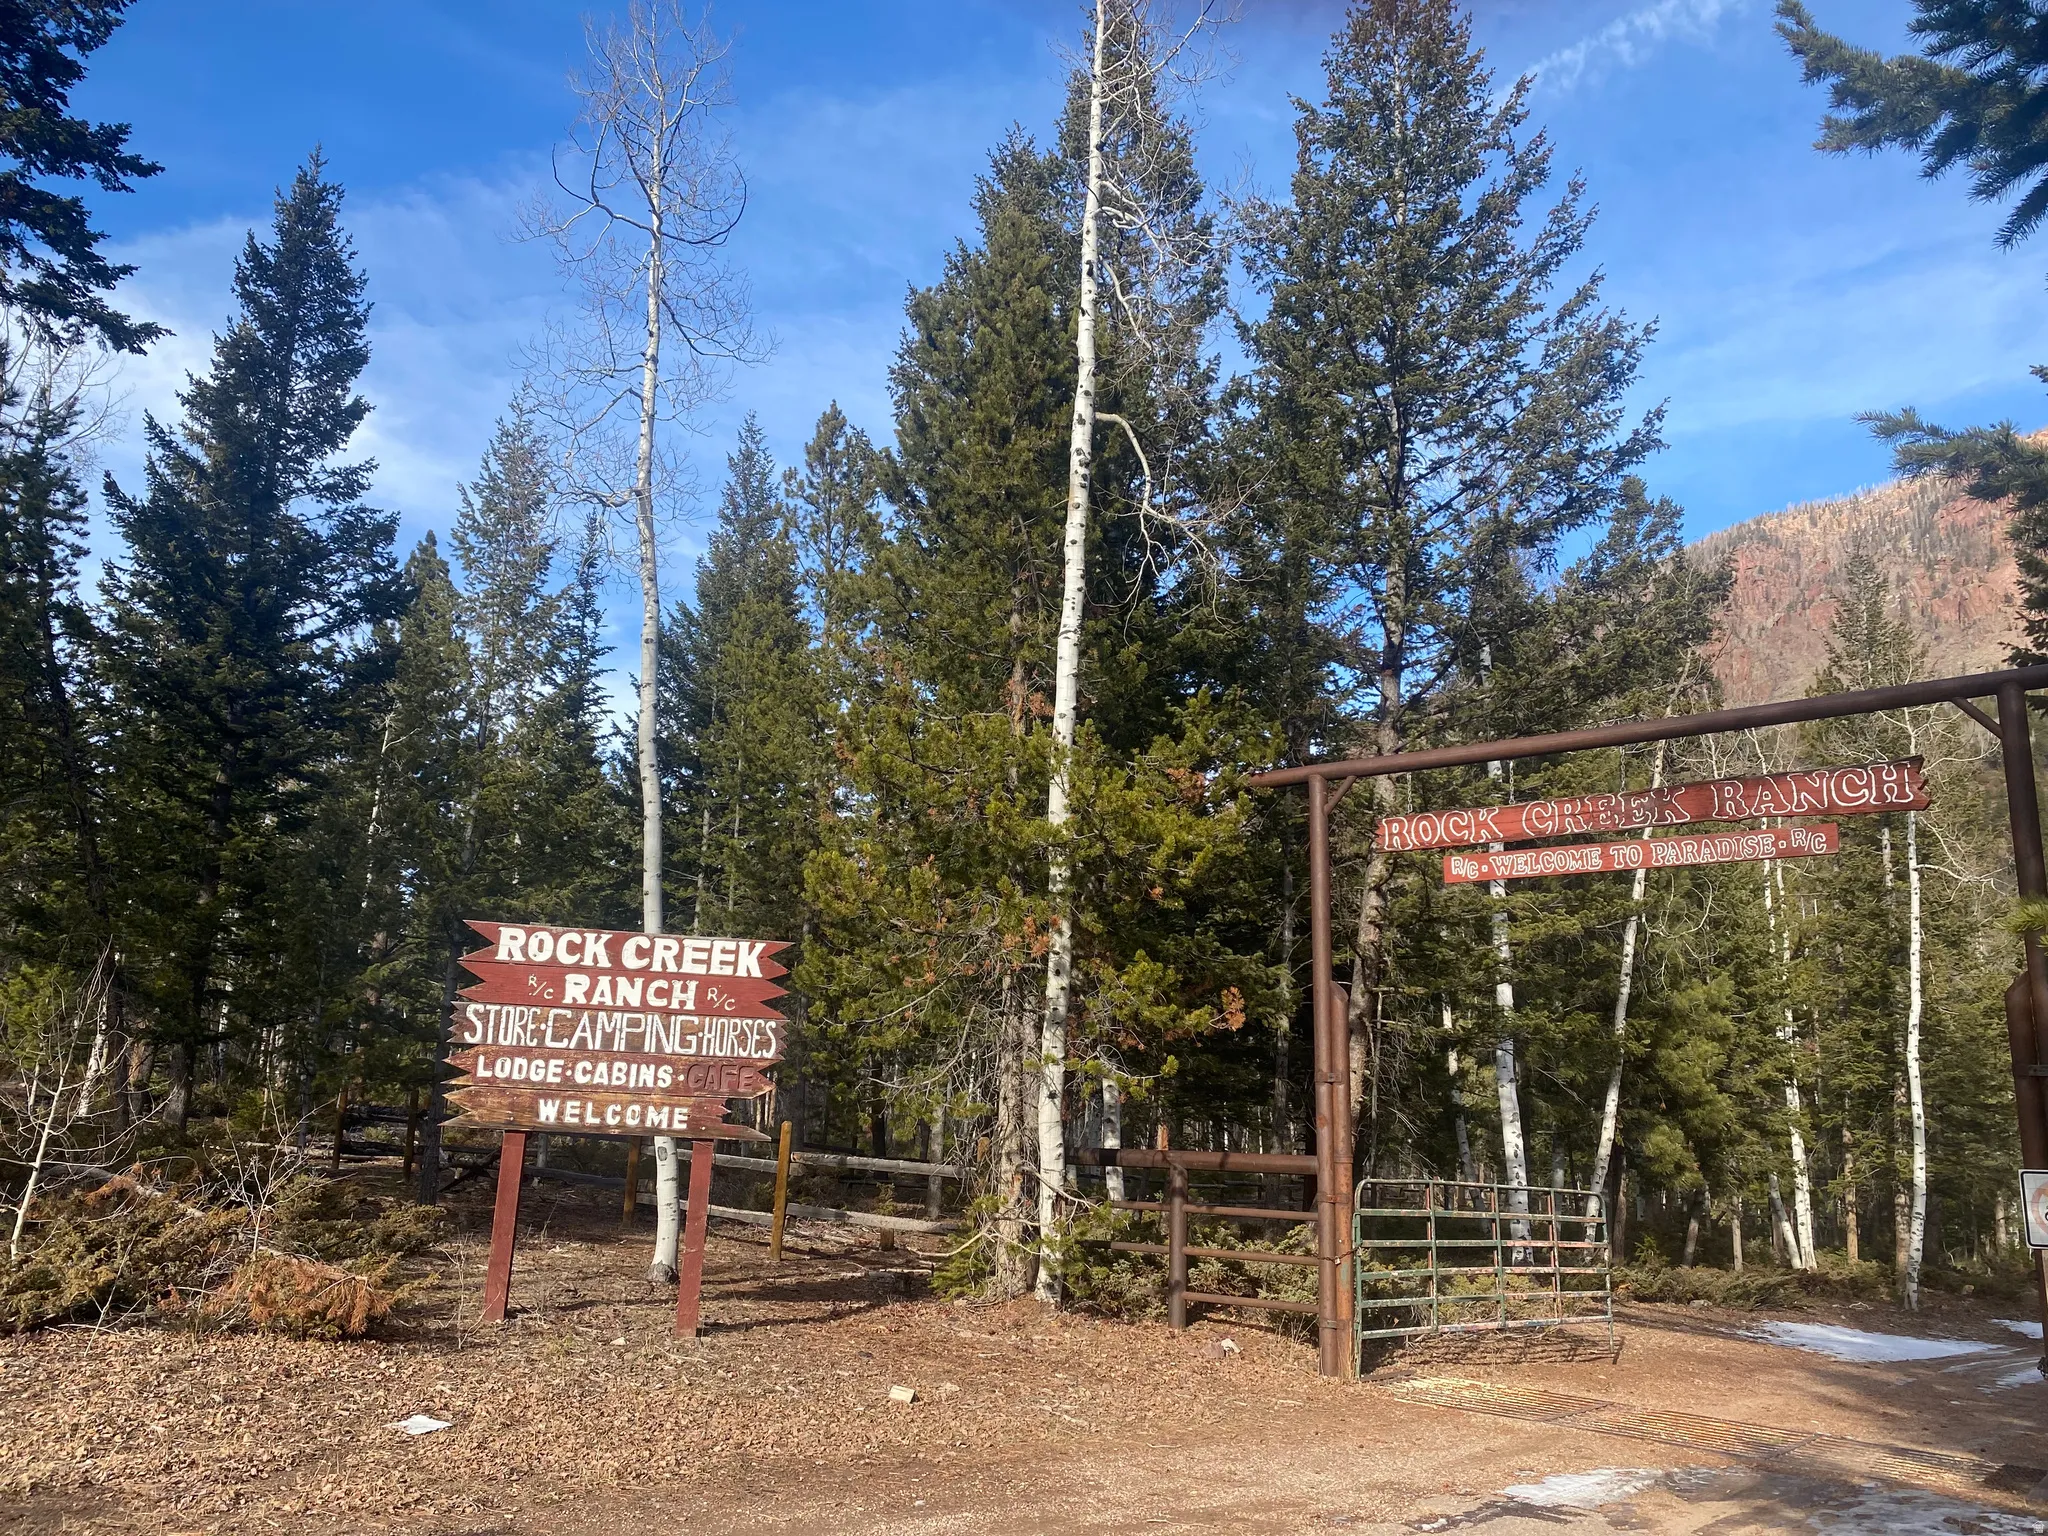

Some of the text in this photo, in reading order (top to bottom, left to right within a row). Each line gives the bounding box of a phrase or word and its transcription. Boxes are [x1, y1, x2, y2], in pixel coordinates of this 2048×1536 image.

[1382, 761, 1914, 850] ROCK CREEK RANCH
[1451, 828, 1827, 879] R/C WELCOME TO PARADISE R/C
[494, 926, 767, 978] ROCK CREEK
[562, 973, 699, 1010] RANCH
[463, 1003, 777, 1058] STORE CAMPING HORSES
[476, 1055, 755, 1090] LODGE CABINS CAFE
[537, 1099, 690, 1129] WELCOME
